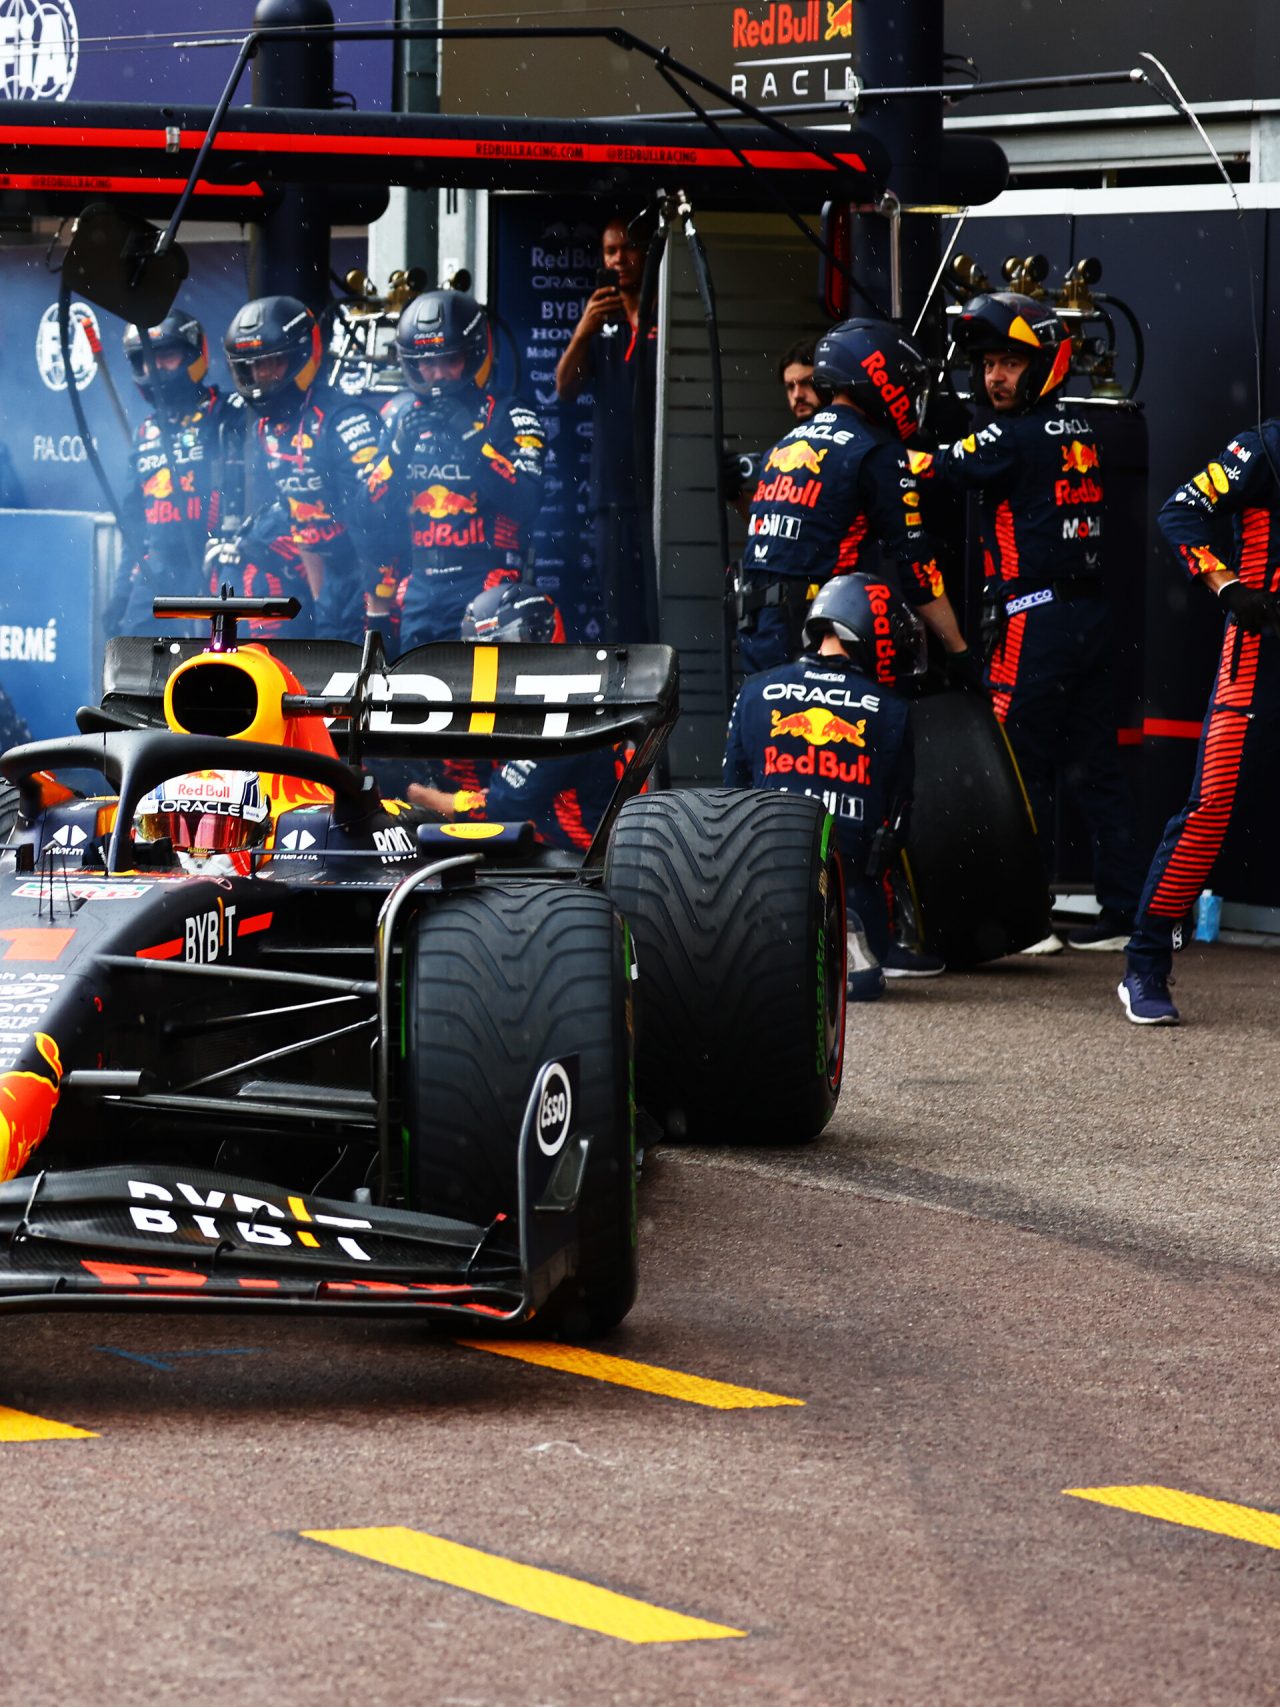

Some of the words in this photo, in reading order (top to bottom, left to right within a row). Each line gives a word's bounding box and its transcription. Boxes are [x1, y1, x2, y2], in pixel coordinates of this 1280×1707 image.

[733, 3, 776, 48] Red
[777, 0, 820, 44] Bull
[475, 143, 585, 159] REDBULLRACING.COM
[607, 146, 698, 163] @REDBULLRACING
[531, 275, 597, 289] ORACL
[861, 350, 905, 403] Red
[778, 475, 822, 509] Bull
[1005, 588, 1054, 615] sparco
[763, 683, 881, 713] ORACLE
[764, 746, 815, 776] Red
[178, 783, 203, 796] Red
[206, 785, 230, 798] Bull
[161, 802, 241, 817] ORACLE
[185, 897, 237, 964] BYBIT
[20, 972, 66, 982] App
[541, 1090, 565, 1128] Esso
